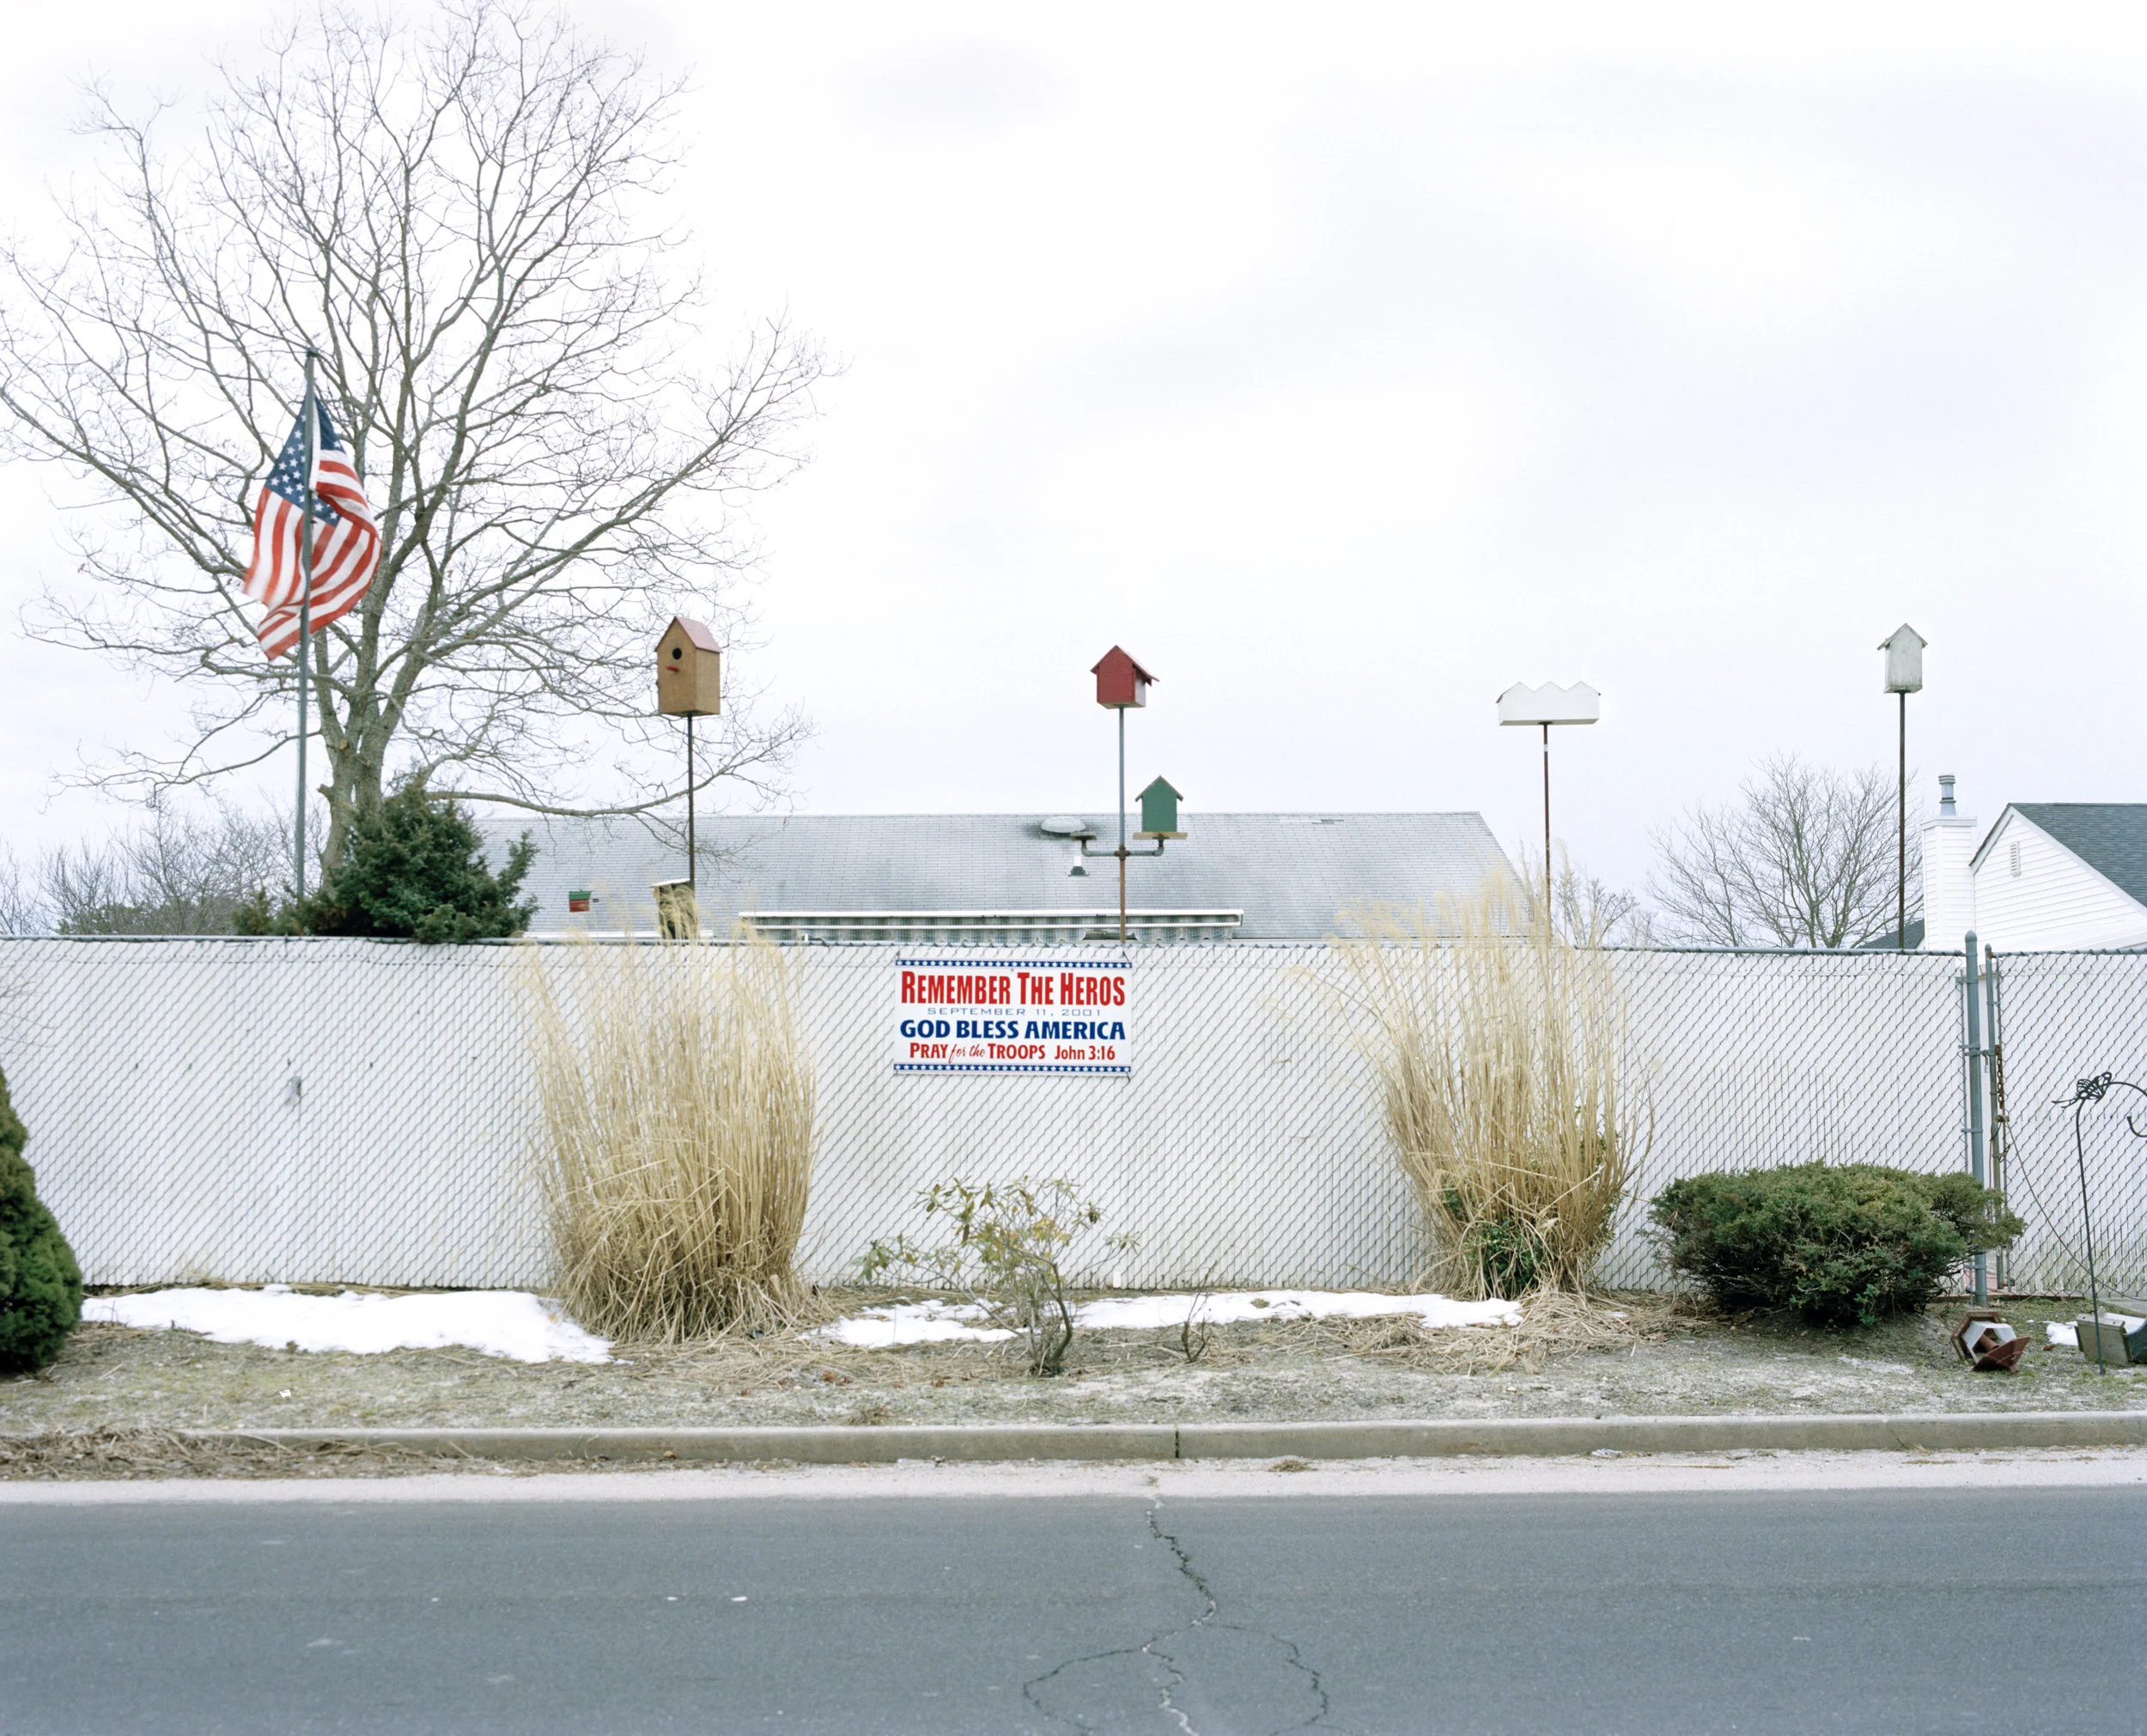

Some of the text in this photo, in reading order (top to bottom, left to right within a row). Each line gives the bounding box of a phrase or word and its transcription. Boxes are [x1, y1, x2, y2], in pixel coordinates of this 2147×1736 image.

[901, 971, 1126, 1006] REMEMBER THE HEROS
[928, 1007, 1025, 1016] SEPTEMBER
[1035, 1009, 1054, 1017] 11,
[901, 1019, 1126, 1041] GOD BLESS AMERICA
[909, 1042, 1116, 1064] PRAY for the TROOPS John 3:16
